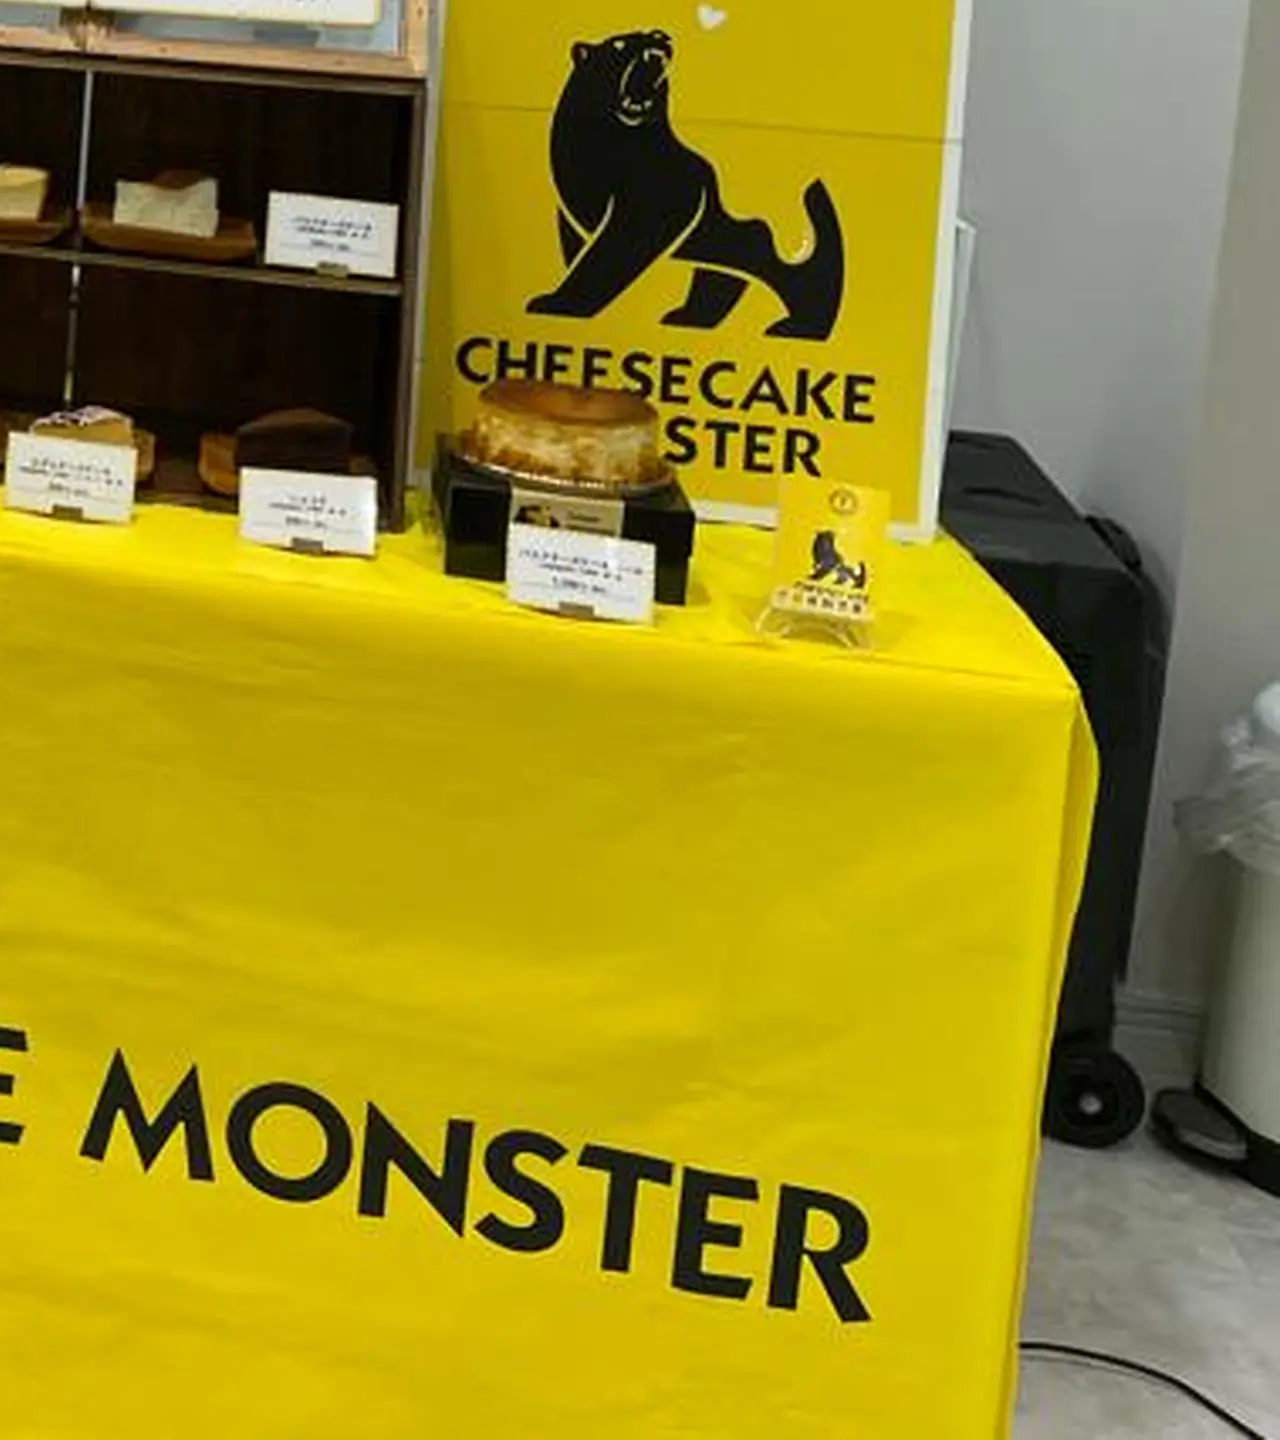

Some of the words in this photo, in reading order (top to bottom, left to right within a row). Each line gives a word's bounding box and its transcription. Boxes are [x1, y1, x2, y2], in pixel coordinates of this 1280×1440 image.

[456, 335, 877, 424] CHEESECAKE
[663, 415, 822, 478] STER
[80, 1049, 870, 1322] MONSTER
